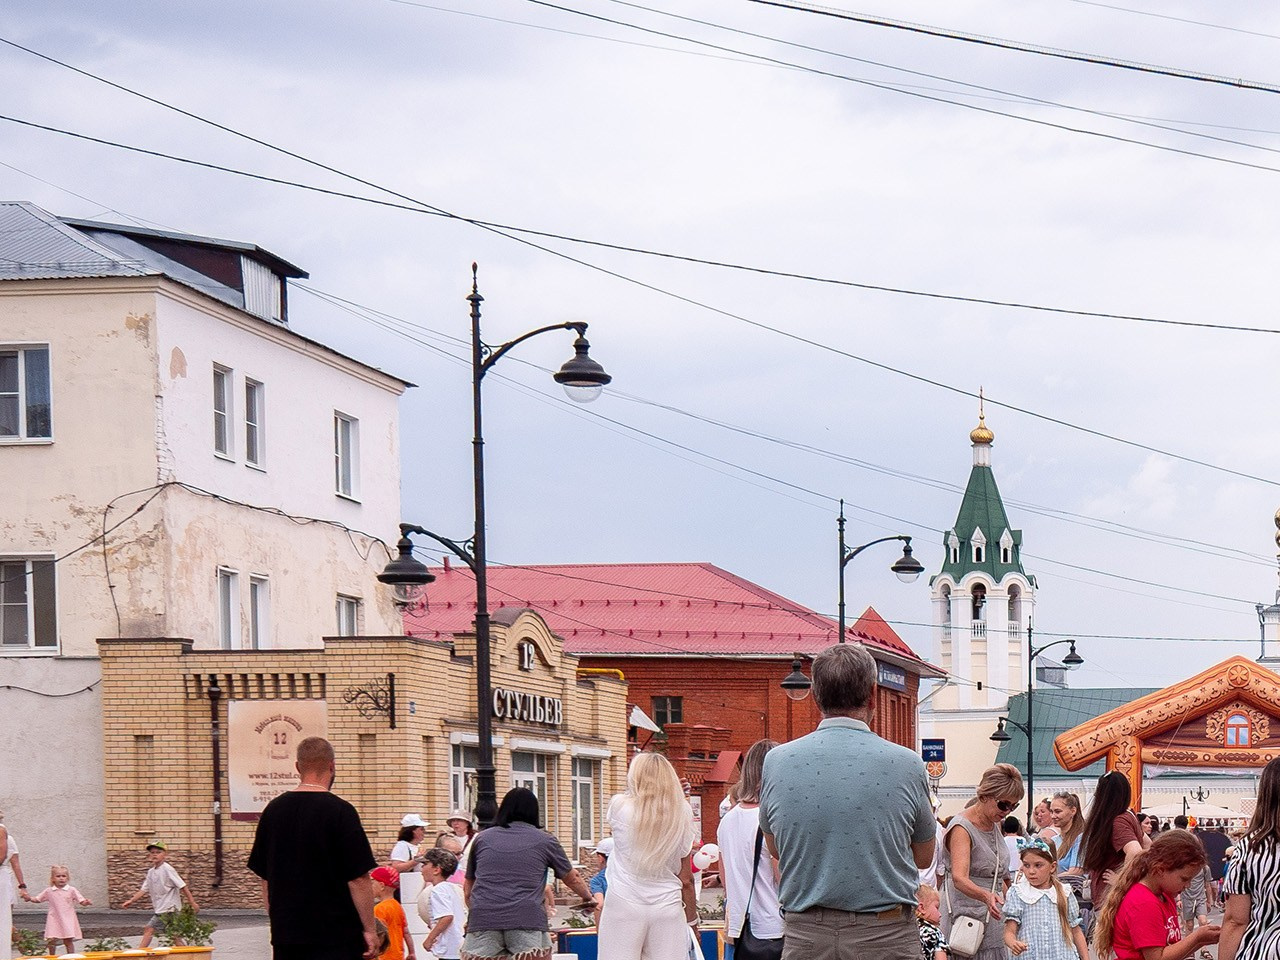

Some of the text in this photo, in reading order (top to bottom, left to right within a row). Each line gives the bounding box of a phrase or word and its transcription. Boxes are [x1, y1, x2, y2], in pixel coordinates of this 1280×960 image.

[523, 642, 536, 670] 12
[493, 688, 563, 725] СТУЛЬЕВ
[273, 732, 287, 745] 12
